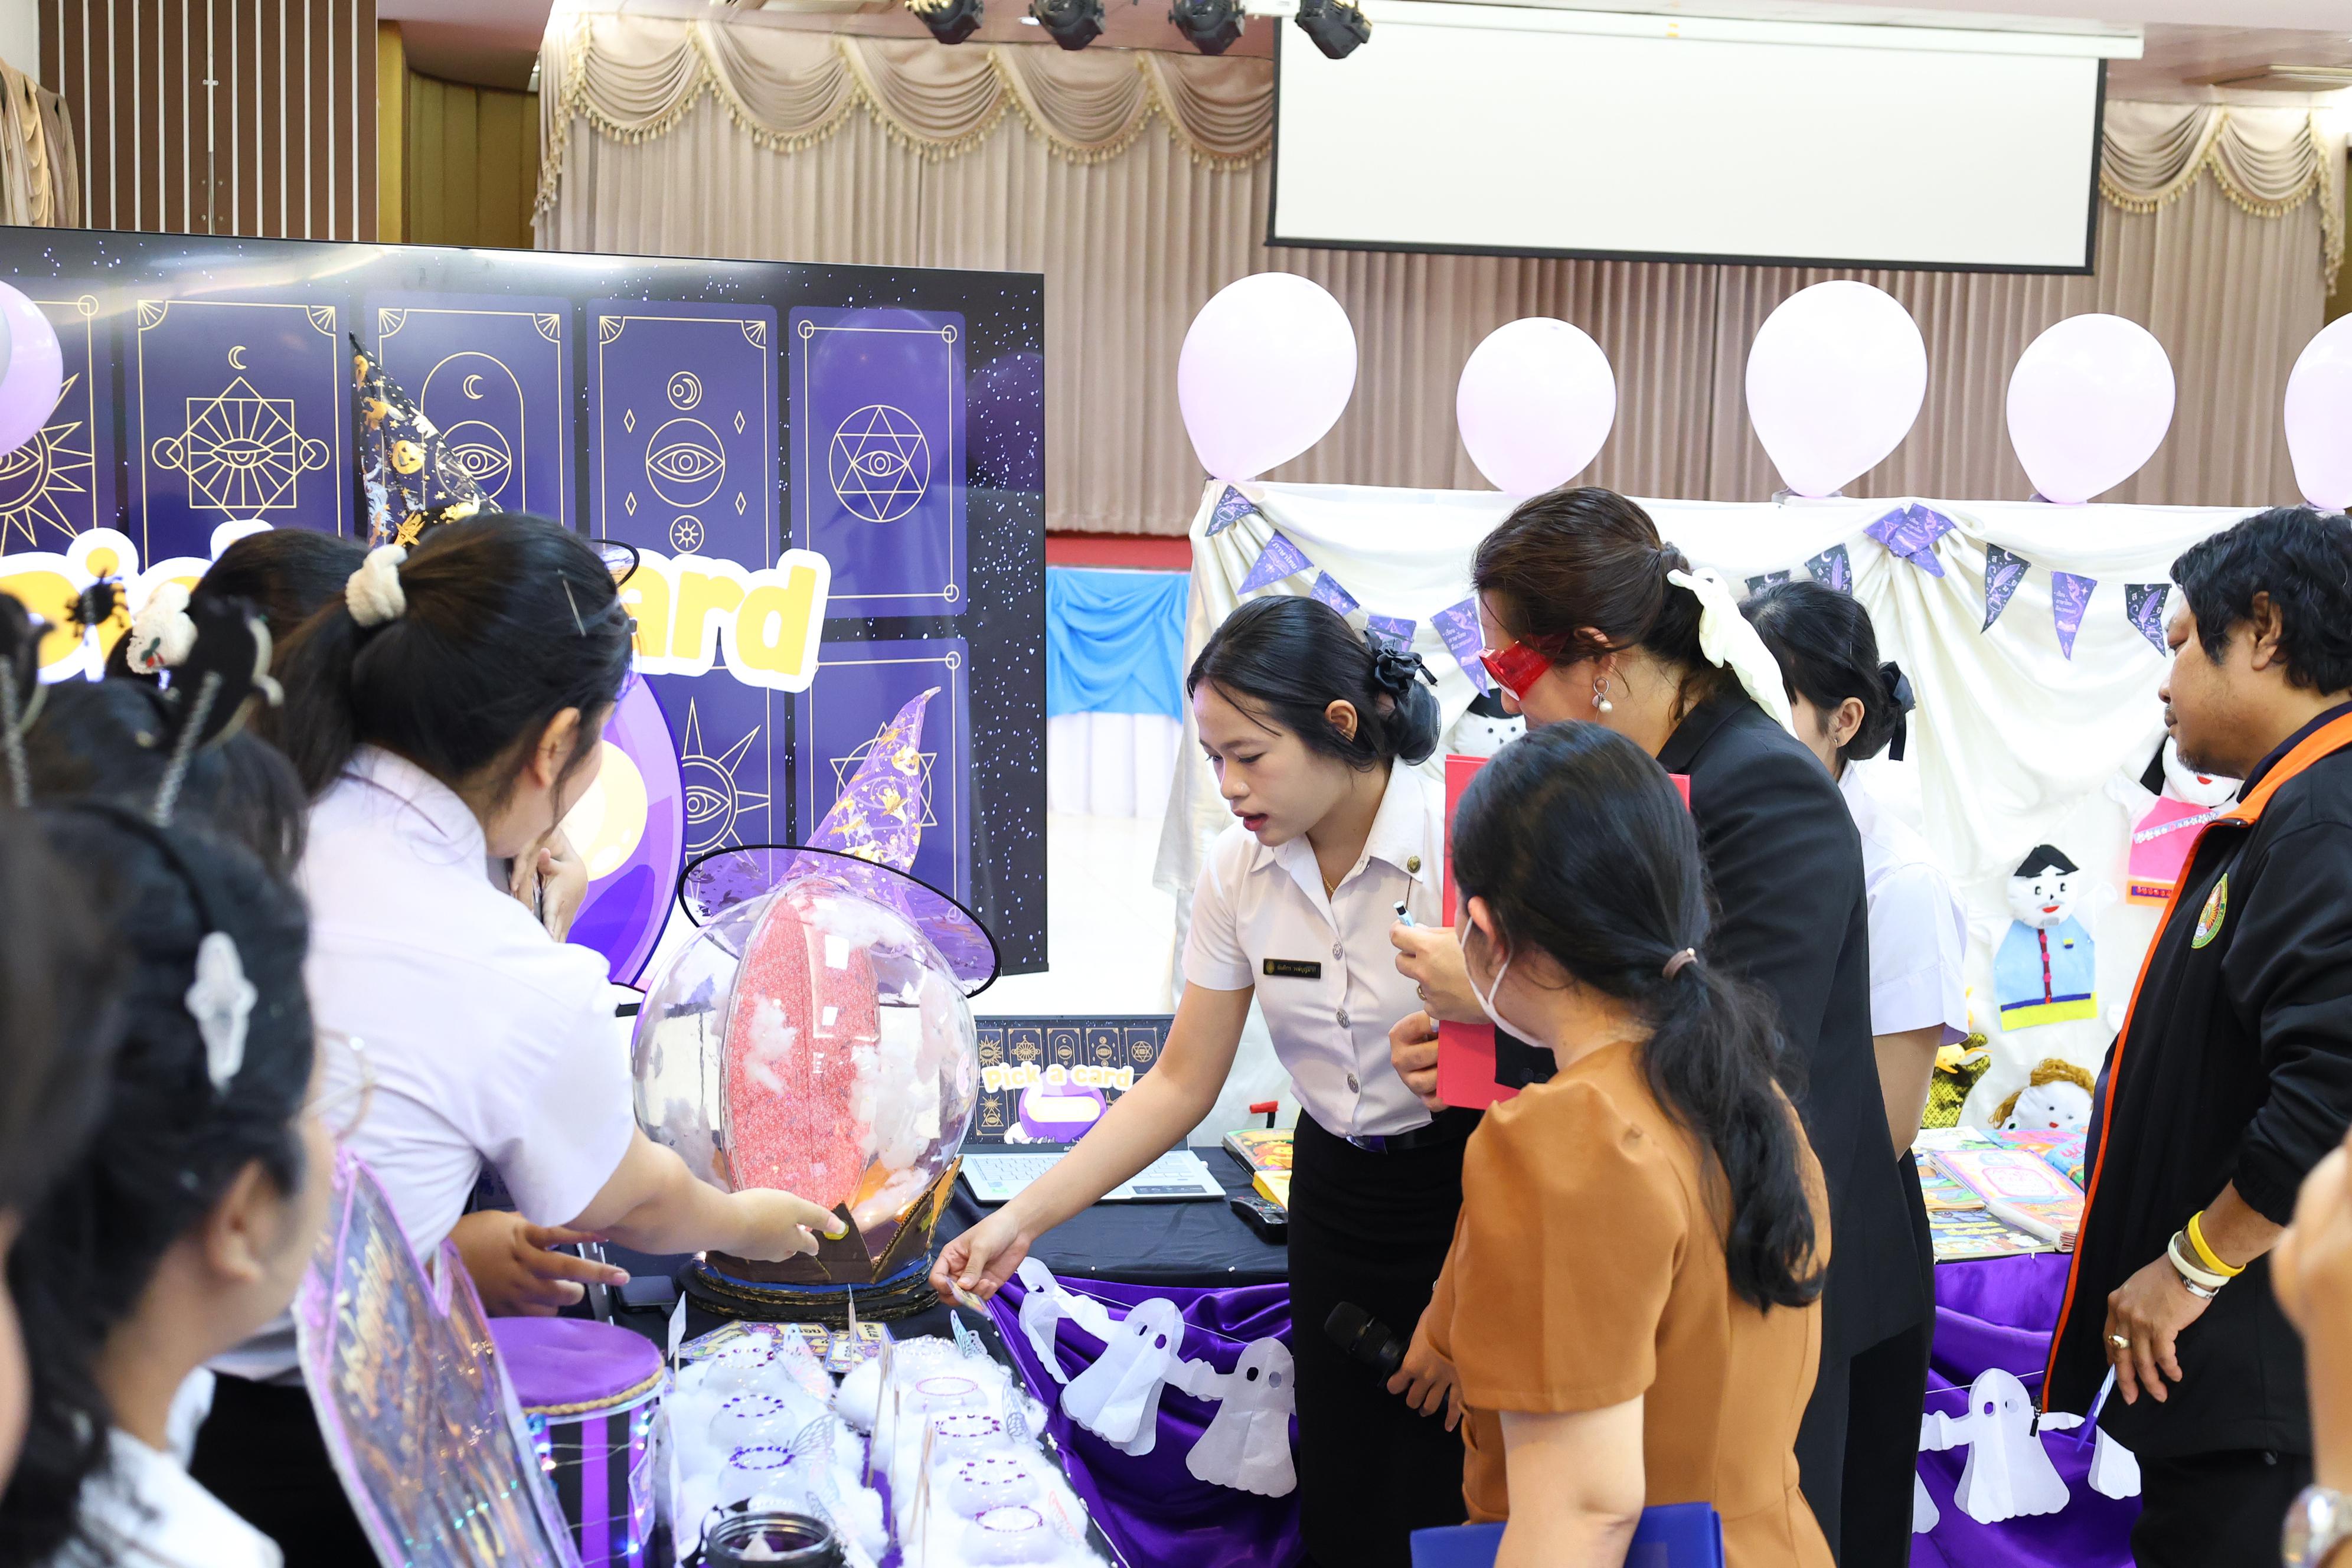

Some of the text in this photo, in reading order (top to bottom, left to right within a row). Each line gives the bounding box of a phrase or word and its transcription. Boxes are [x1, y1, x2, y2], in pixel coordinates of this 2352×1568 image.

[1272, 543, 1298, 569] ภาษาไทย
[618, 563, 817, 677] ard
[984, 1064, 1132, 1090] Pick a card
